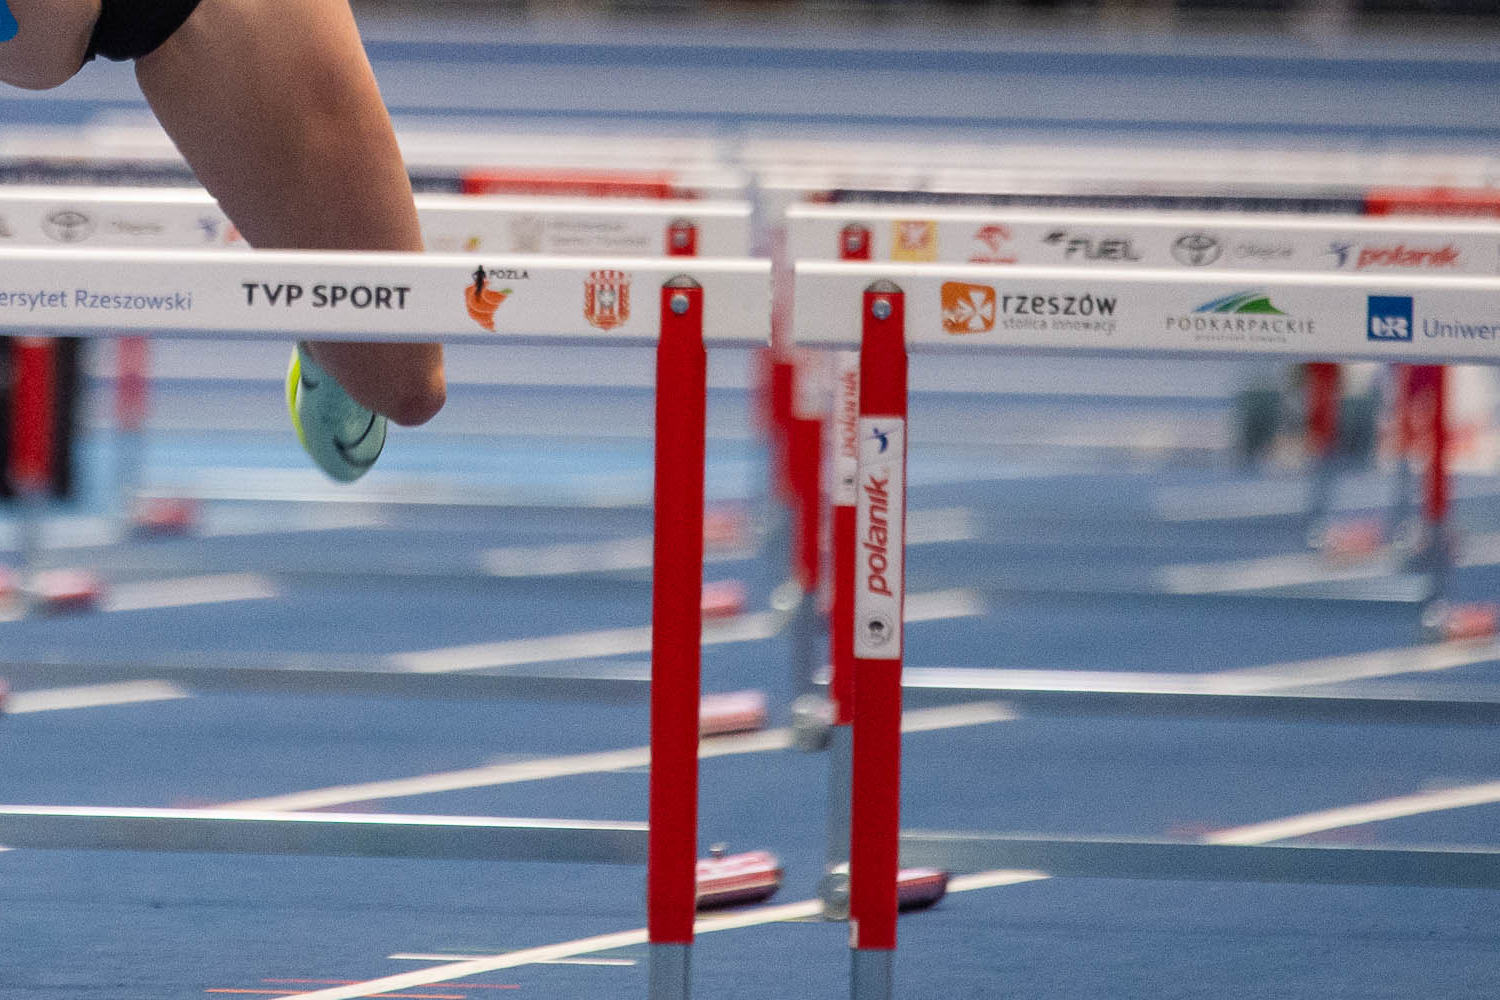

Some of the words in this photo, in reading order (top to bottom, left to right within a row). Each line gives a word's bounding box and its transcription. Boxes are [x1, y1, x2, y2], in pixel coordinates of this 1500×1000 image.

[75, 288, 192, 311] Rzeszowski
[242, 283, 304, 307] TVP
[311, 285, 412, 310] SPORT
[1002, 293, 1118, 317] rzeszów
[1165, 317, 1317, 335] PODKARPACKIE
[862, 473, 893, 598] polanik
